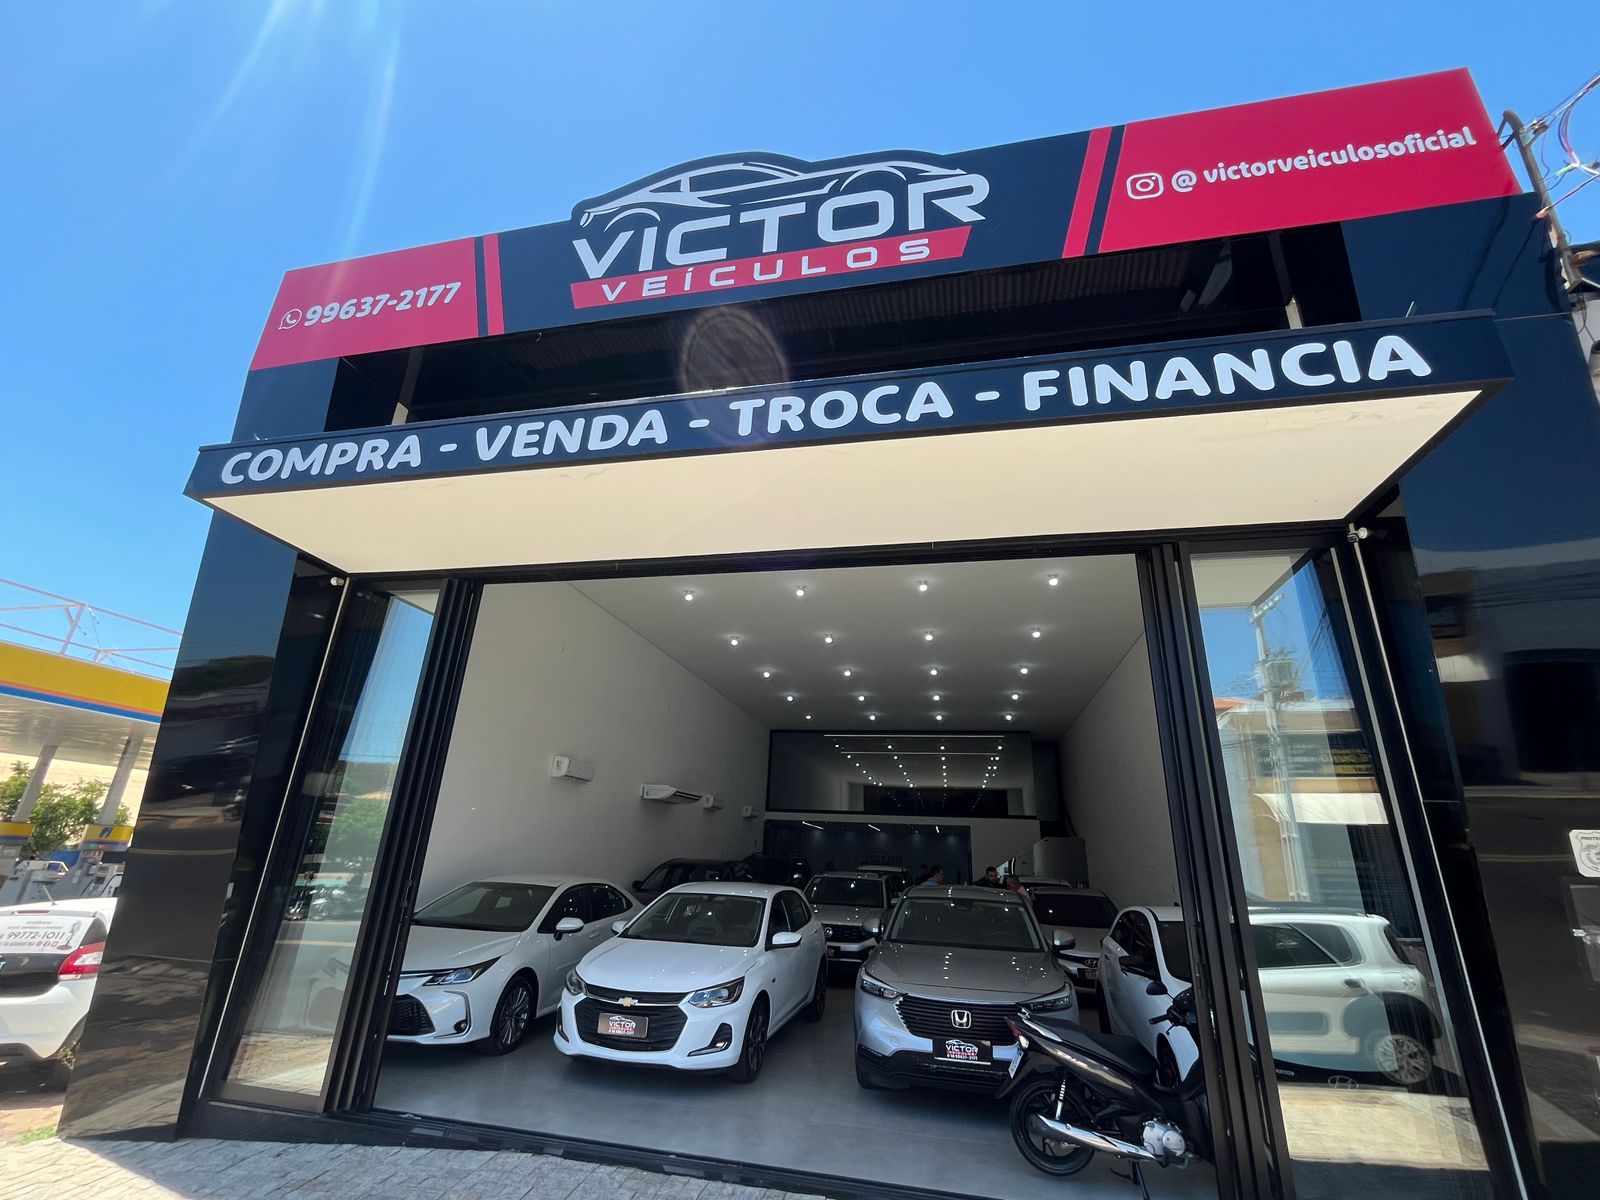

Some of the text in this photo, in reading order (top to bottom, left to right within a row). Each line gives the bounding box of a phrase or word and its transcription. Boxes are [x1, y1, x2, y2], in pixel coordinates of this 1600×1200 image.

[1203, 126, 1477, 184] victorveiculosoficial
[572, 173, 989, 279] VICTOR
[602, 238, 930, 301] VEÍCULOS
[304, 281, 462, 327] 99637-2177
[221, 434, 421, 485] COMPRA
[475, 409, 669, 461] VENDA
[729, 381, 953, 436] TROCA
[1023, 335, 1432, 412] FINANCIA
[609, 1021, 636, 1029] VICTOR
[945, 1044, 978, 1053] VICTOR
